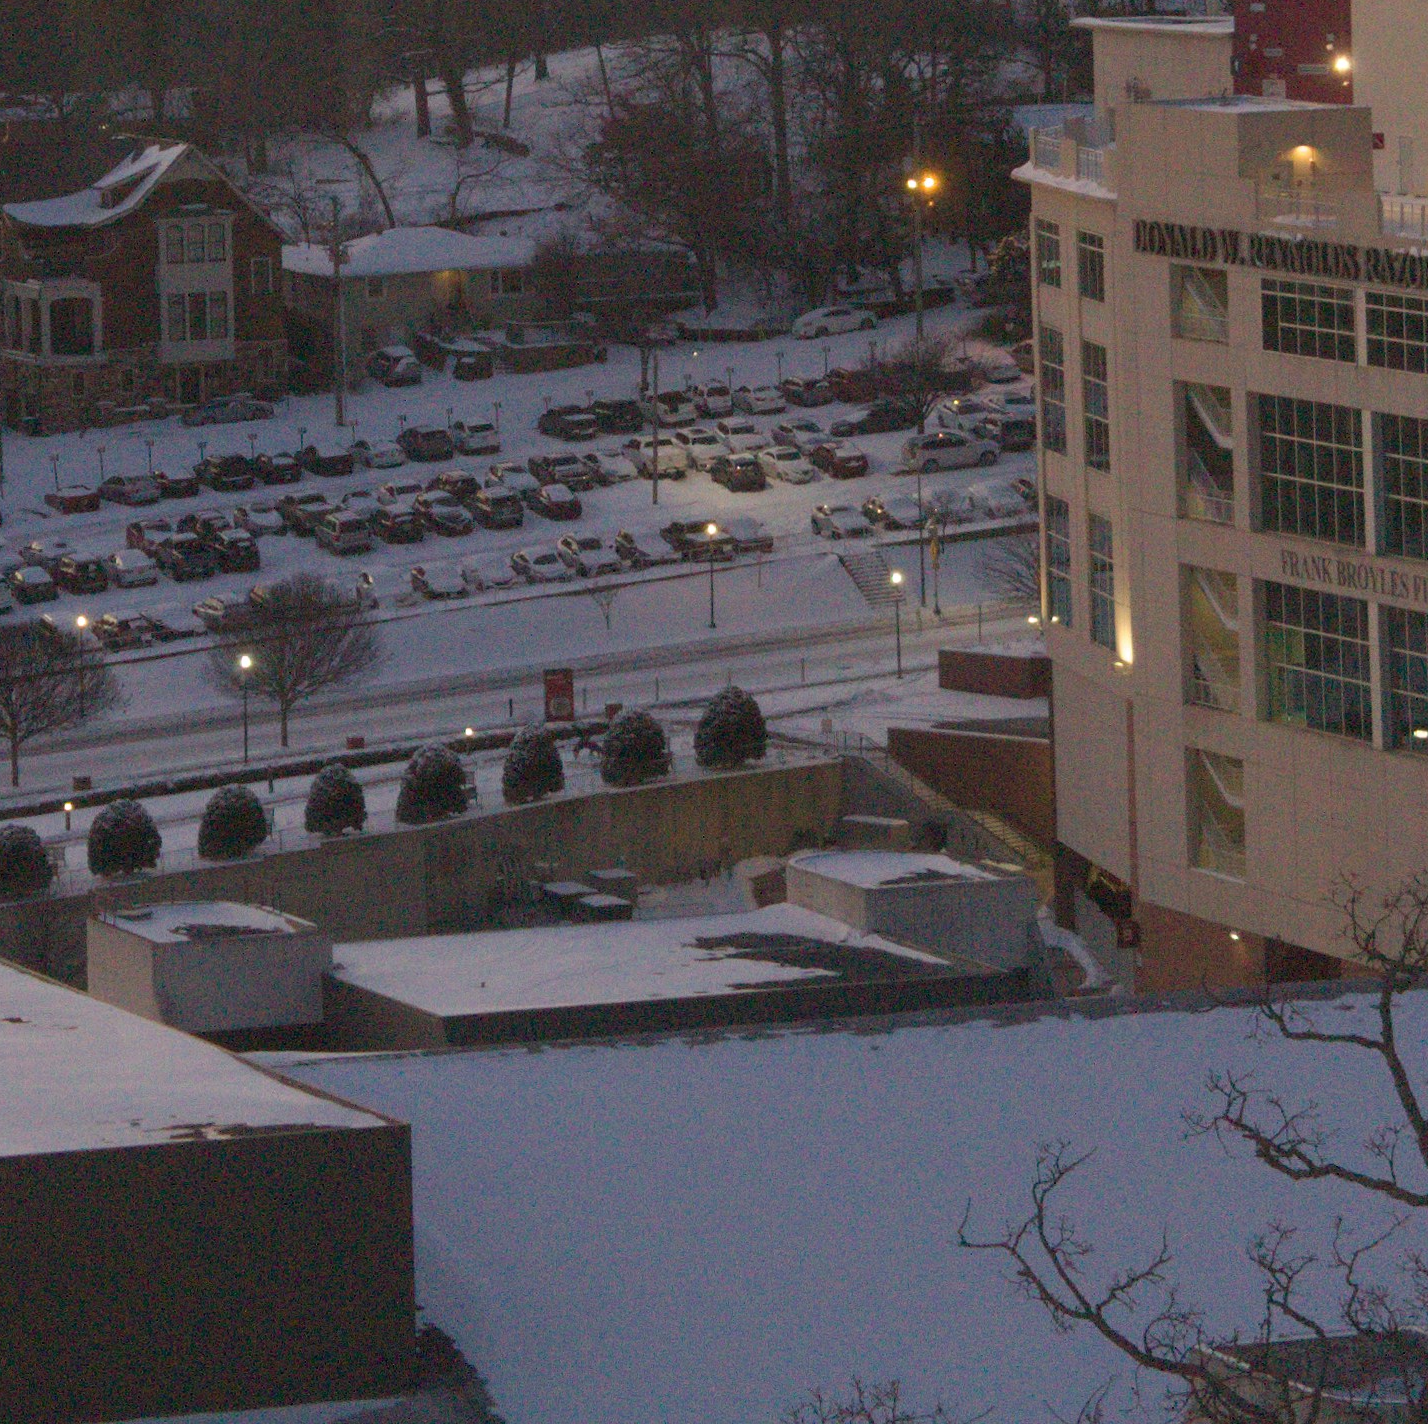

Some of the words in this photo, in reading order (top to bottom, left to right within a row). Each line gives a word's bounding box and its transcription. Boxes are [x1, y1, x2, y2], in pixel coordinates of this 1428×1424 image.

[1134, 219, 1218, 262] DONALD
[1282, 550, 1333, 585] FRANK
[1336, 560, 1410, 599] BROYLES
